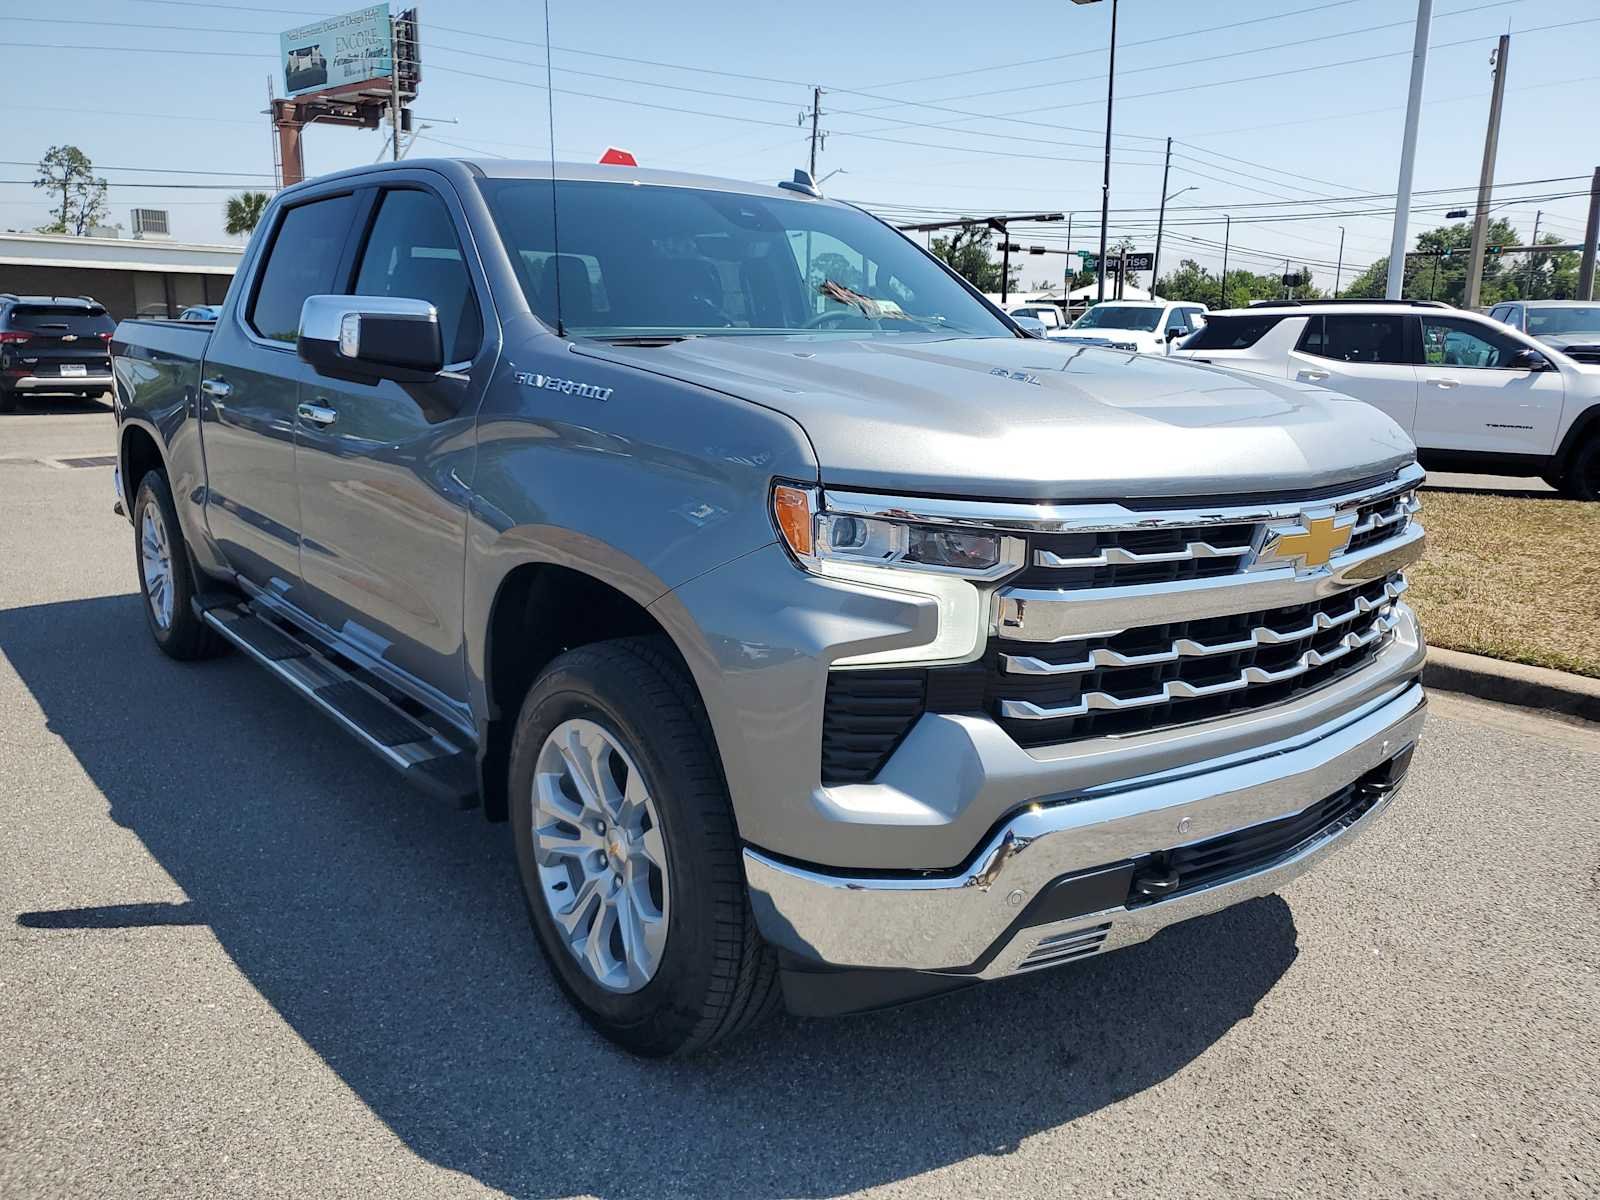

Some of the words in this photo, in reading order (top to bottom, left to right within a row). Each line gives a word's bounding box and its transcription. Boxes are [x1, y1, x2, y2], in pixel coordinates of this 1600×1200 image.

[335, 27, 380, 53] ENCORE
[1086, 255, 1149, 270] enerrise
[514, 370, 614, 401] SILVERADO
